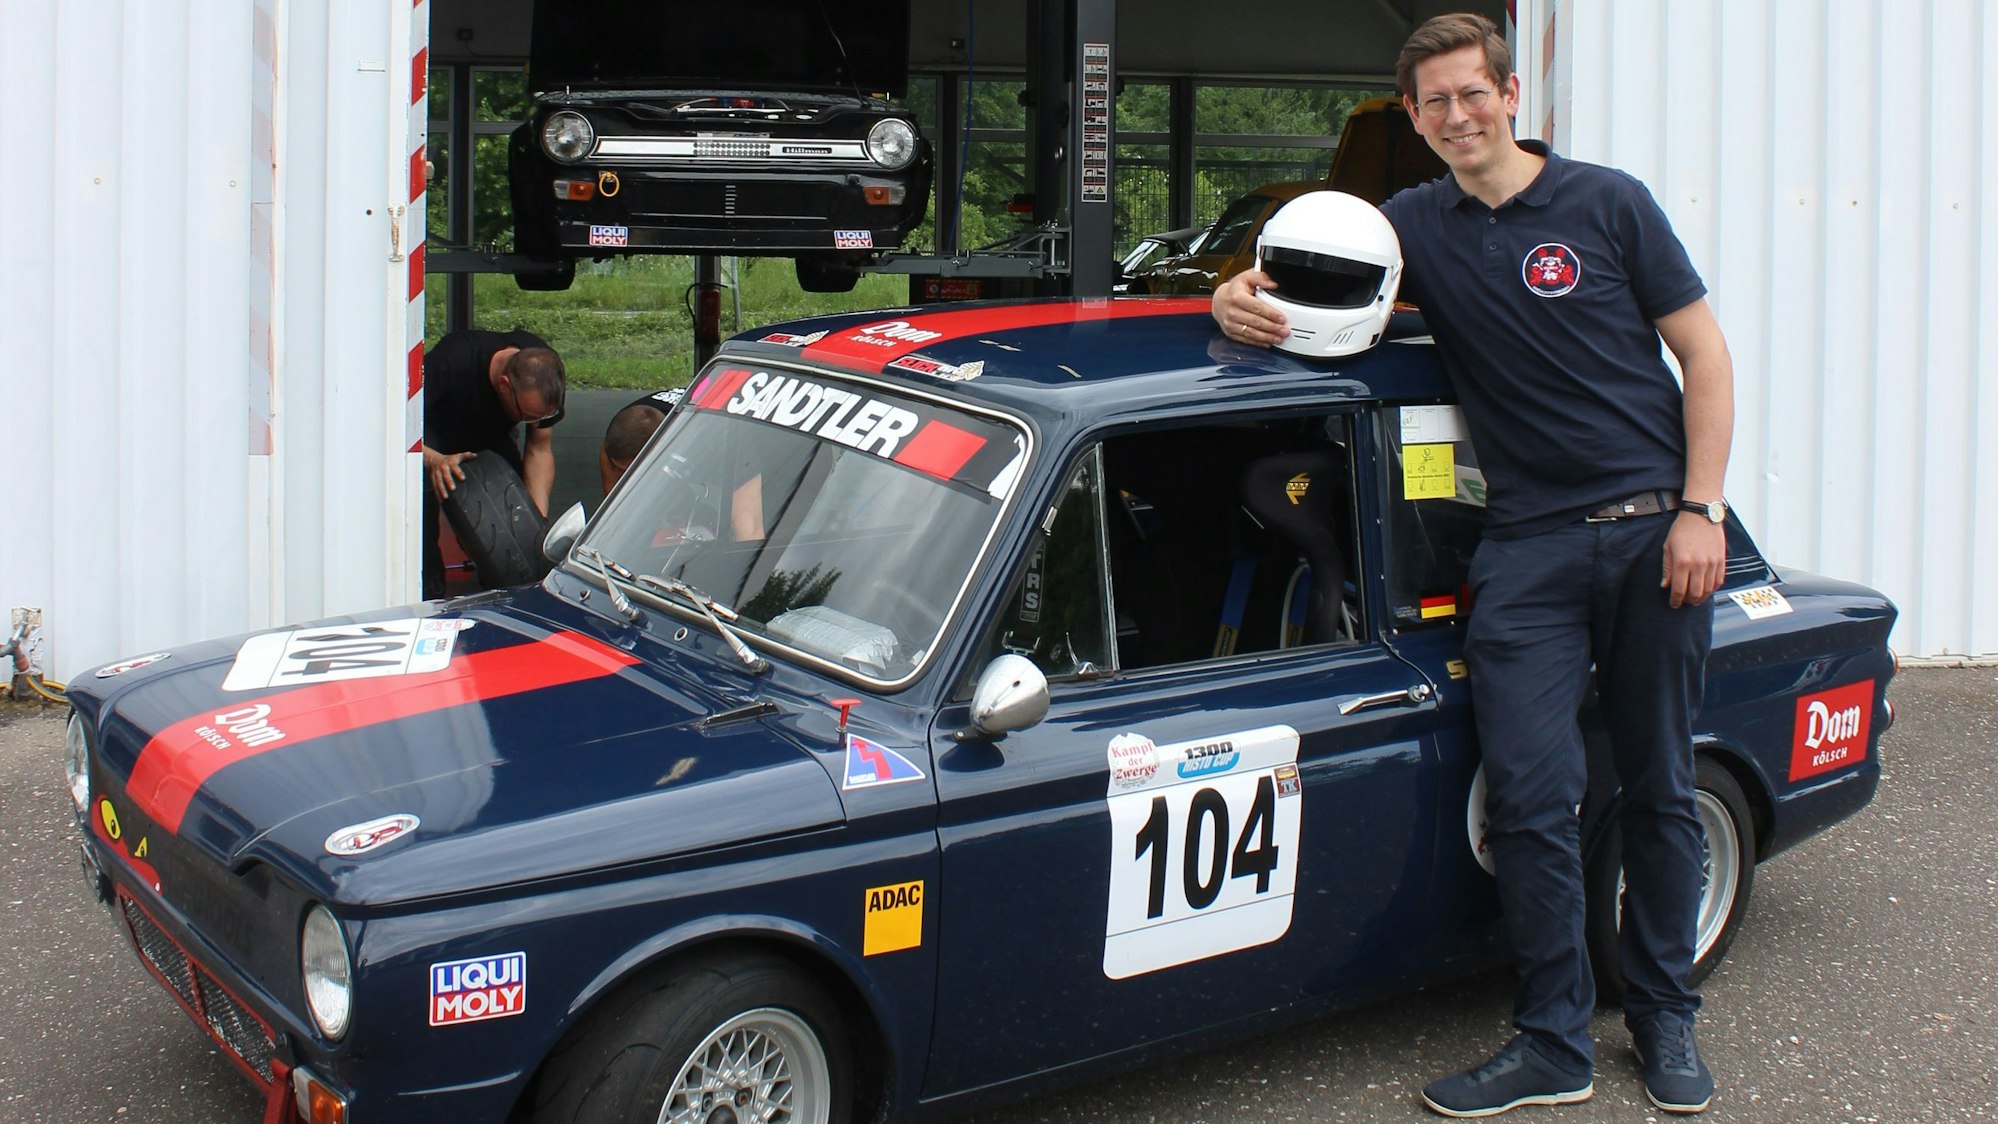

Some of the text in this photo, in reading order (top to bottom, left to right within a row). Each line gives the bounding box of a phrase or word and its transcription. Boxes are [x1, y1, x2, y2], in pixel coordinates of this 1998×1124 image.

[592, 227, 626, 236] LIQUI
[592, 235, 626, 245] MOLY
[836, 231, 869, 240] LIQUI
[838, 239, 871, 248] MOLY
[860, 321, 943, 343] Dom
[726, 371, 919, 459] SANDTLER
[281, 626, 412, 676] 104
[215, 703, 287, 748] Dom
[1804, 700, 1861, 750] Dom
[194, 726, 232, 750] KÖLSCH
[1111, 741, 1154, 759] Kampf
[1184, 741, 1234, 760] 1300
[1812, 747, 1848, 767] KÖLSCH
[1115, 764, 1157, 779] Zwerge
[1128, 756, 1143, 767] der
[1182, 753, 1235, 773] HISTO CUP
[1135, 775, 1279, 920] 104
[868, 884, 922, 913] ADAC
[437, 956, 520, 993] LIQUI
[437, 985, 522, 1021] MOLY
